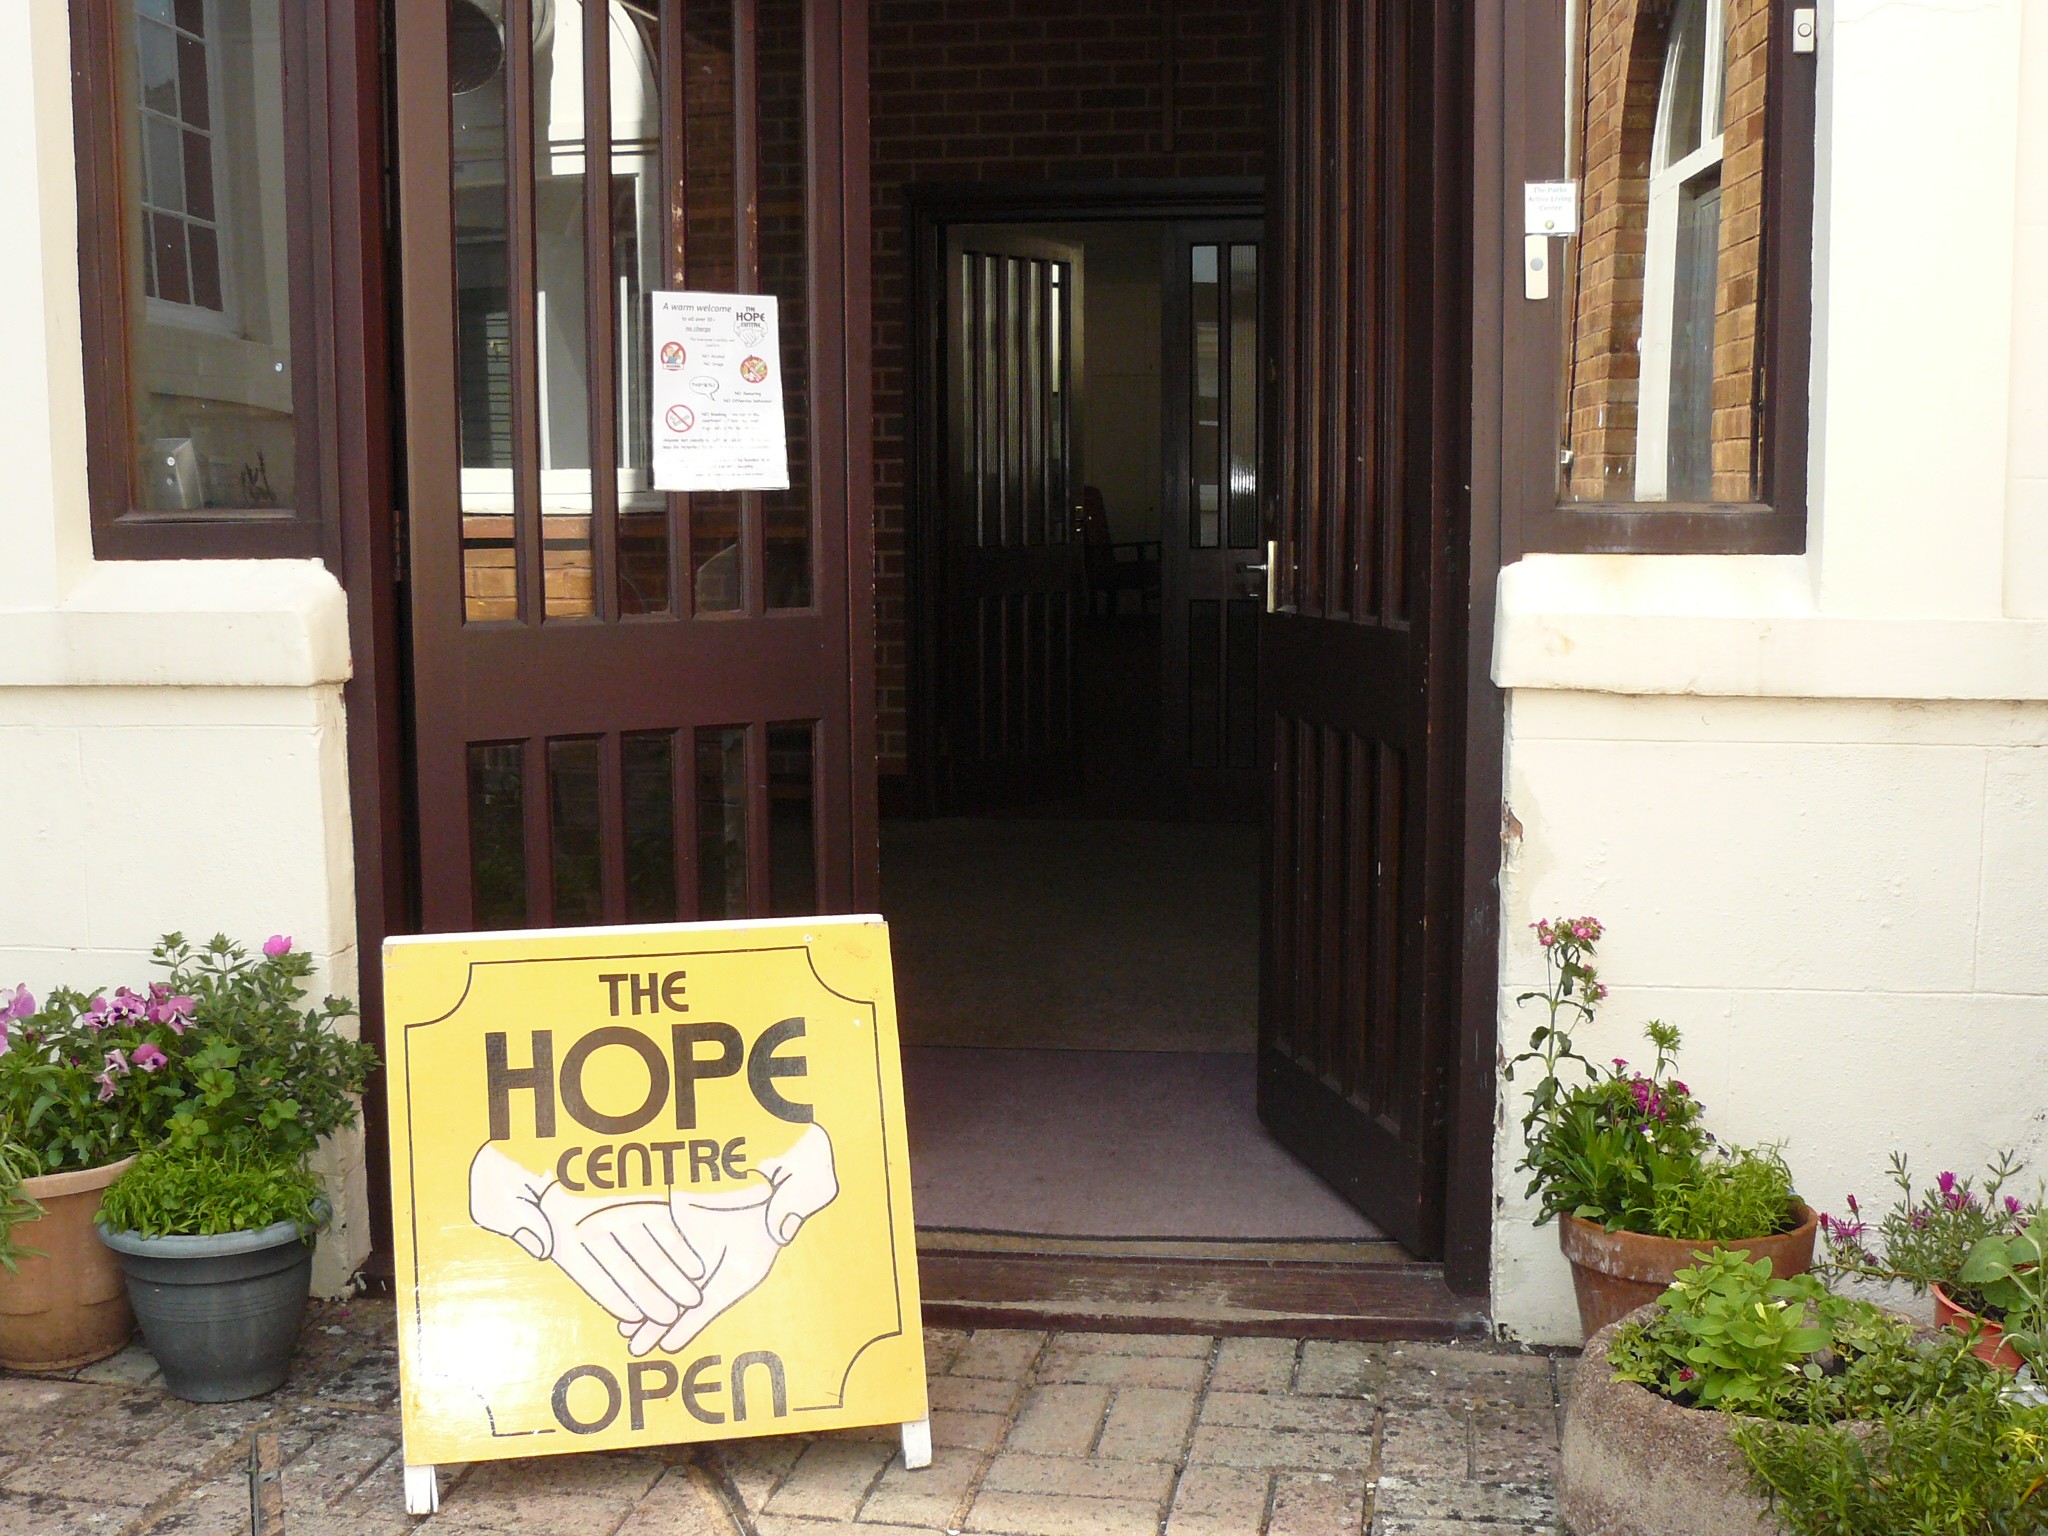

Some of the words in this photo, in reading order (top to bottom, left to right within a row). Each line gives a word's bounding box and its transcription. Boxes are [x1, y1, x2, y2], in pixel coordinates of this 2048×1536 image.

[663, 302, 669, 310] A
[696, 303, 732, 313] welcome
[736, 312, 765, 322] HOPE
[599, 970, 689, 1016] THE
[485, 1017, 814, 1140] HOPE
[556, 1137, 748, 1192] CENTRE
[551, 1351, 787, 1435] OPEN
